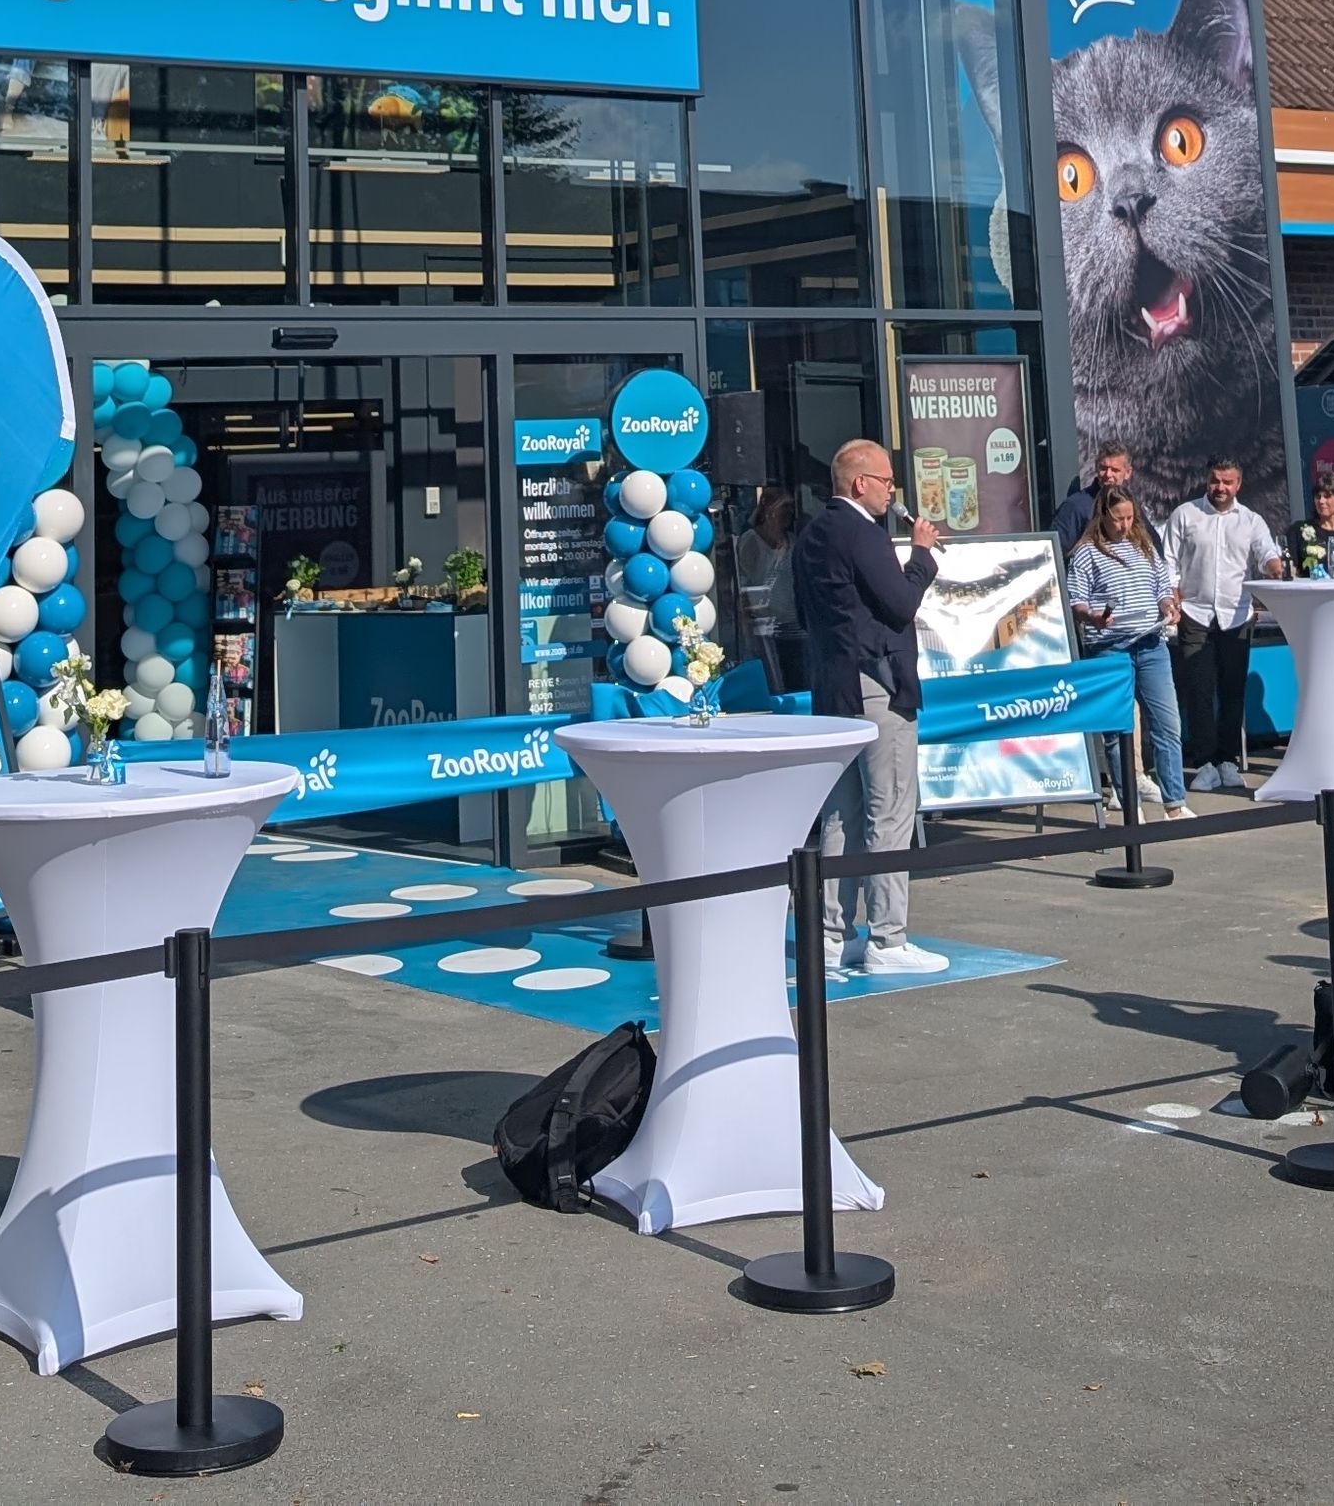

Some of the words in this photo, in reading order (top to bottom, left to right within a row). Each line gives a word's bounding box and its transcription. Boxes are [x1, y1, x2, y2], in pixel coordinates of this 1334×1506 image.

[909, 374, 936, 393] Aus
[940, 376, 997, 392] unserer
[910, 394, 998, 419] WERBUNG
[621, 413, 695, 437] ZooRoyal
[521, 431, 587, 454] ZooRoyal
[255, 486, 288, 504] Aus
[292, 486, 361, 504] unserer
[522, 478, 571, 497] Herzlich
[259, 504, 358, 531] WERBUNG
[523, 502, 596, 521] willkommen
[524, 542, 557, 552] montags
[524, 556, 540, 564] von
[528, 678, 555, 689] REWE
[977, 690, 1071, 721] ZooRoyal
[427, 741, 545, 780] ZooRoyal
[1026, 776, 1072, 791] ZooRoyal
